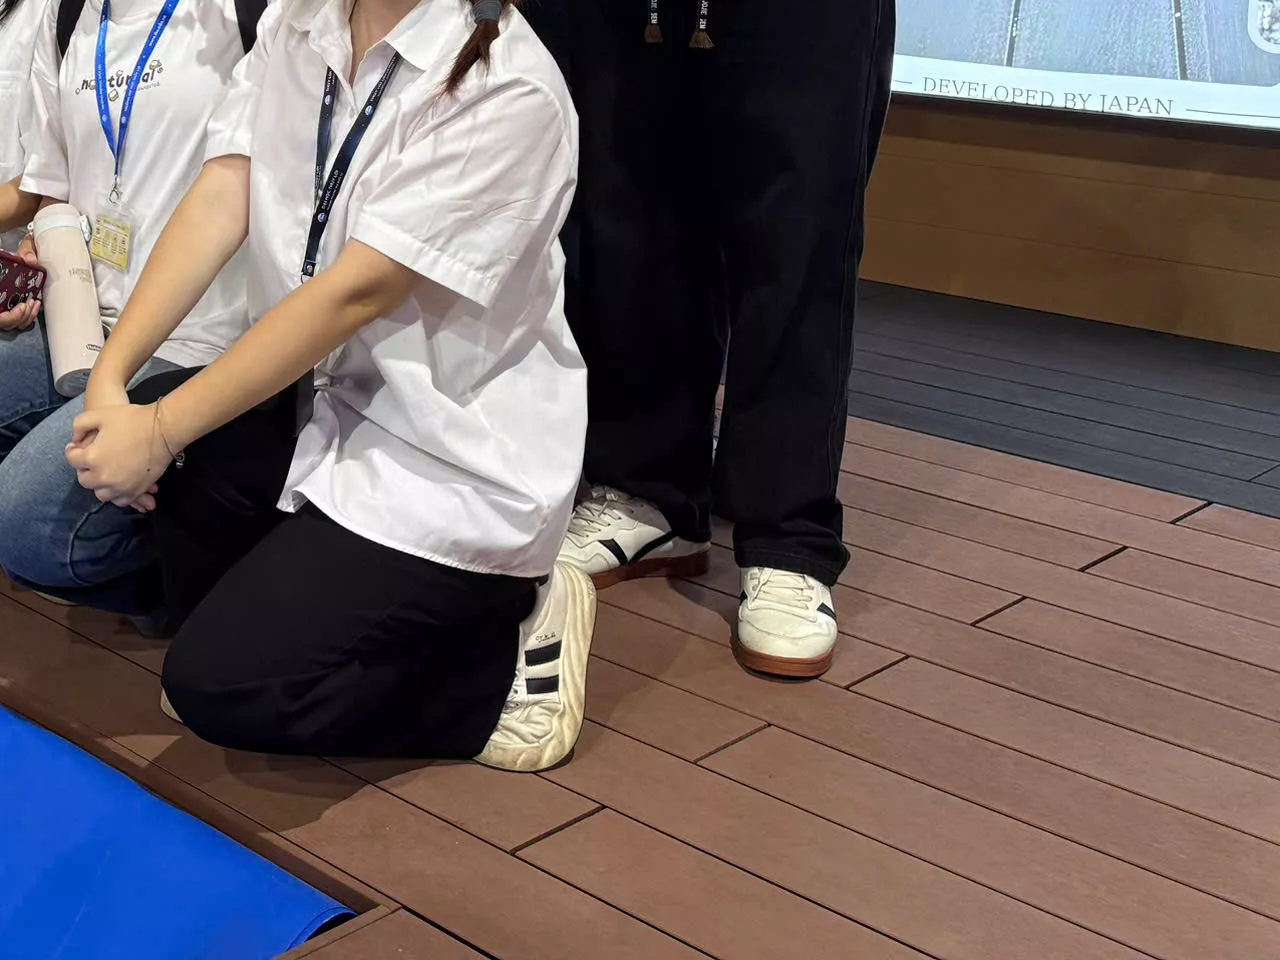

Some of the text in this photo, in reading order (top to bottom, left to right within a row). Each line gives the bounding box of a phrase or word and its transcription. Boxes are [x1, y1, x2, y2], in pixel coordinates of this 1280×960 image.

[923, 76, 1175, 116] DEVELOPED BY JAPAN
